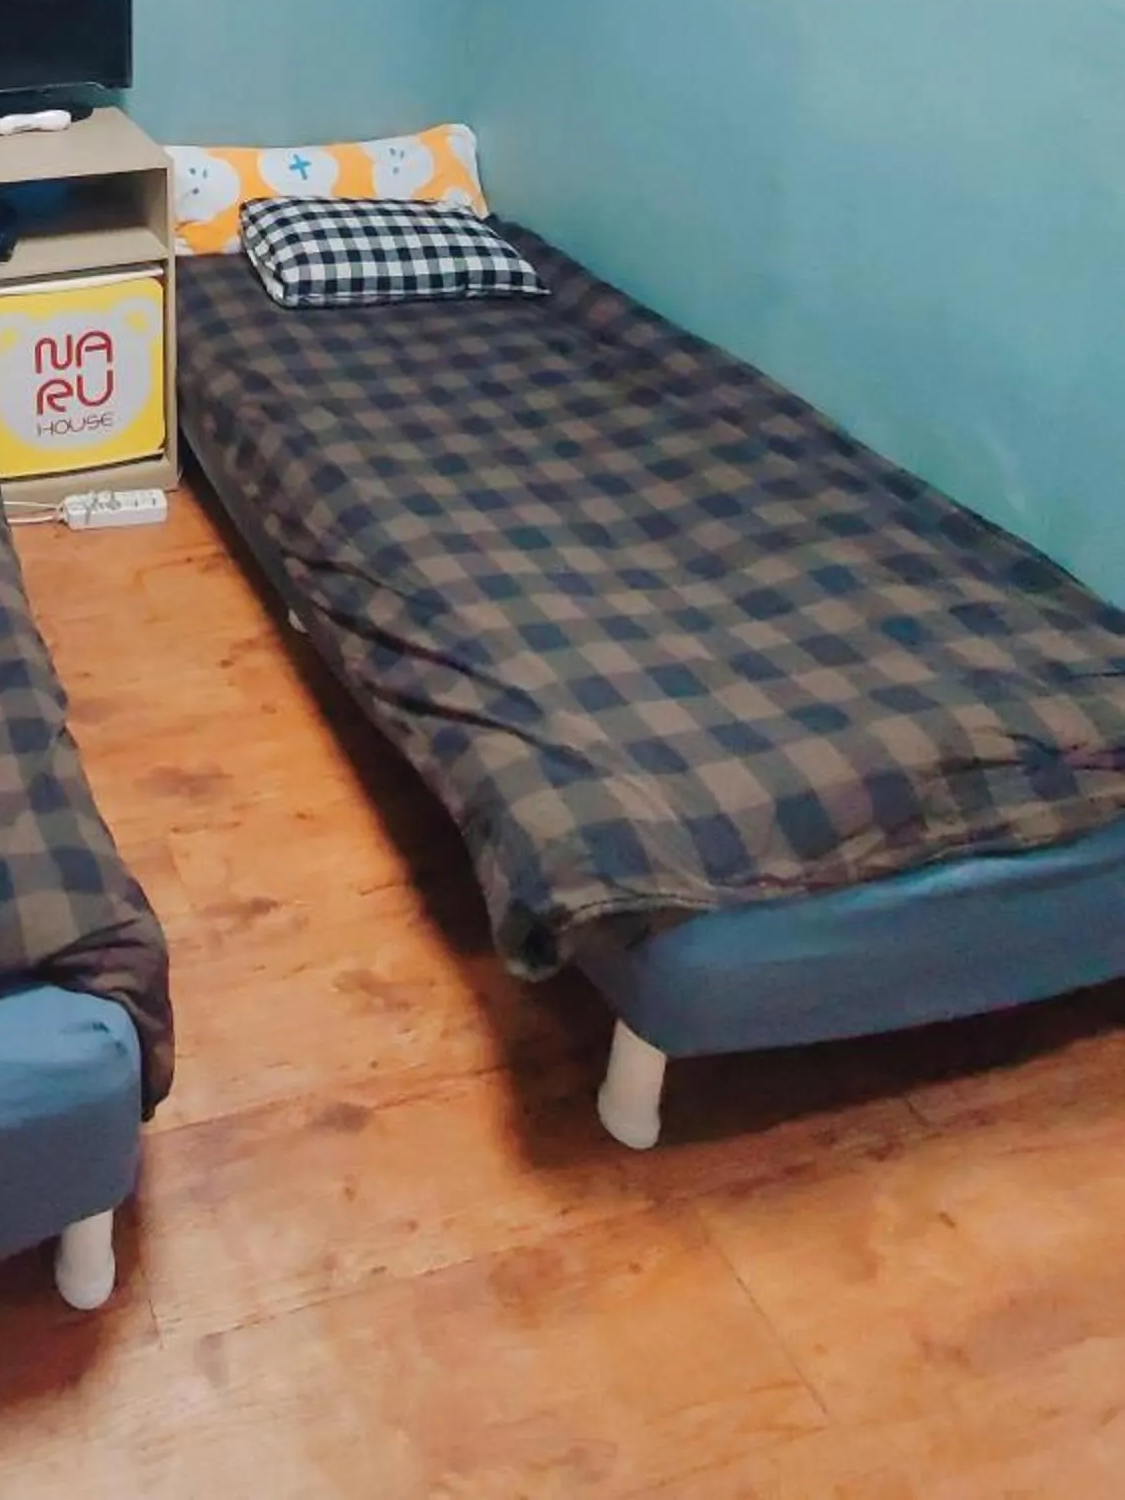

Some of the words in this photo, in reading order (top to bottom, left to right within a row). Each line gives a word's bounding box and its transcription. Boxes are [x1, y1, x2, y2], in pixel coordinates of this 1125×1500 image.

[34, 330, 113, 374] NA
[36, 369, 114, 416] RU
[36, 412, 114, 438] HOUSE
